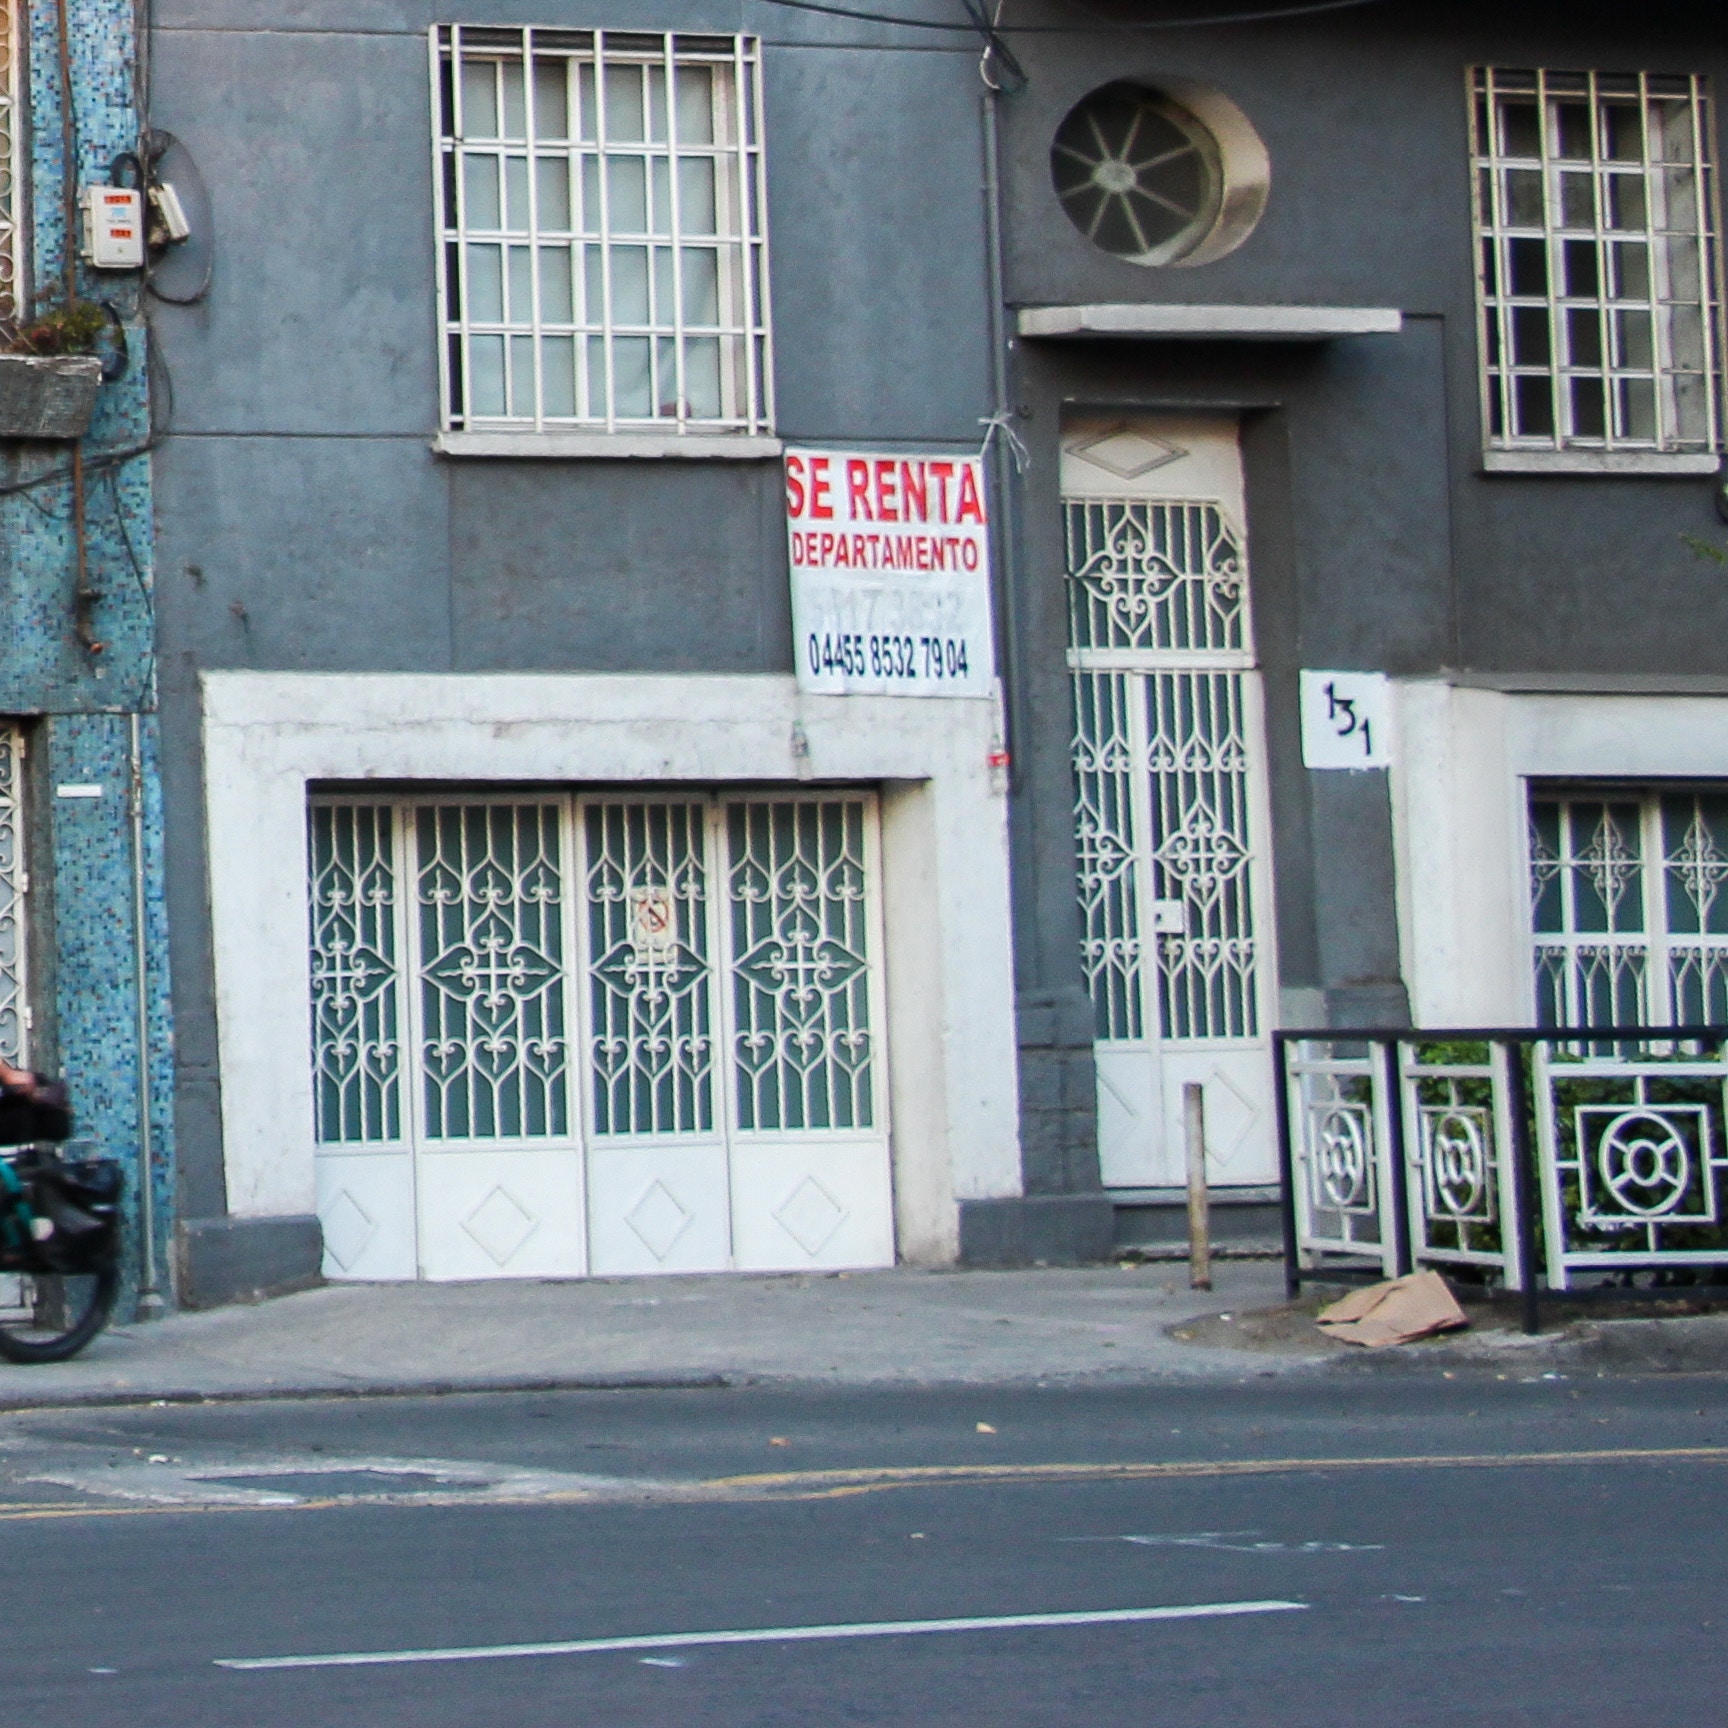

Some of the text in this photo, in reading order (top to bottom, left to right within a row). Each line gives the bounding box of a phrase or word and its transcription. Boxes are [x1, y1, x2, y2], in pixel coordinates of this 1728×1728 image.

[786, 455, 988, 525] SE RENTA
[791, 532, 979, 572] DEPARTAMENTO
[808, 632, 866, 677] 04455
[869, 634, 916, 678] 8532
[1321, 681, 1372, 756] 131
